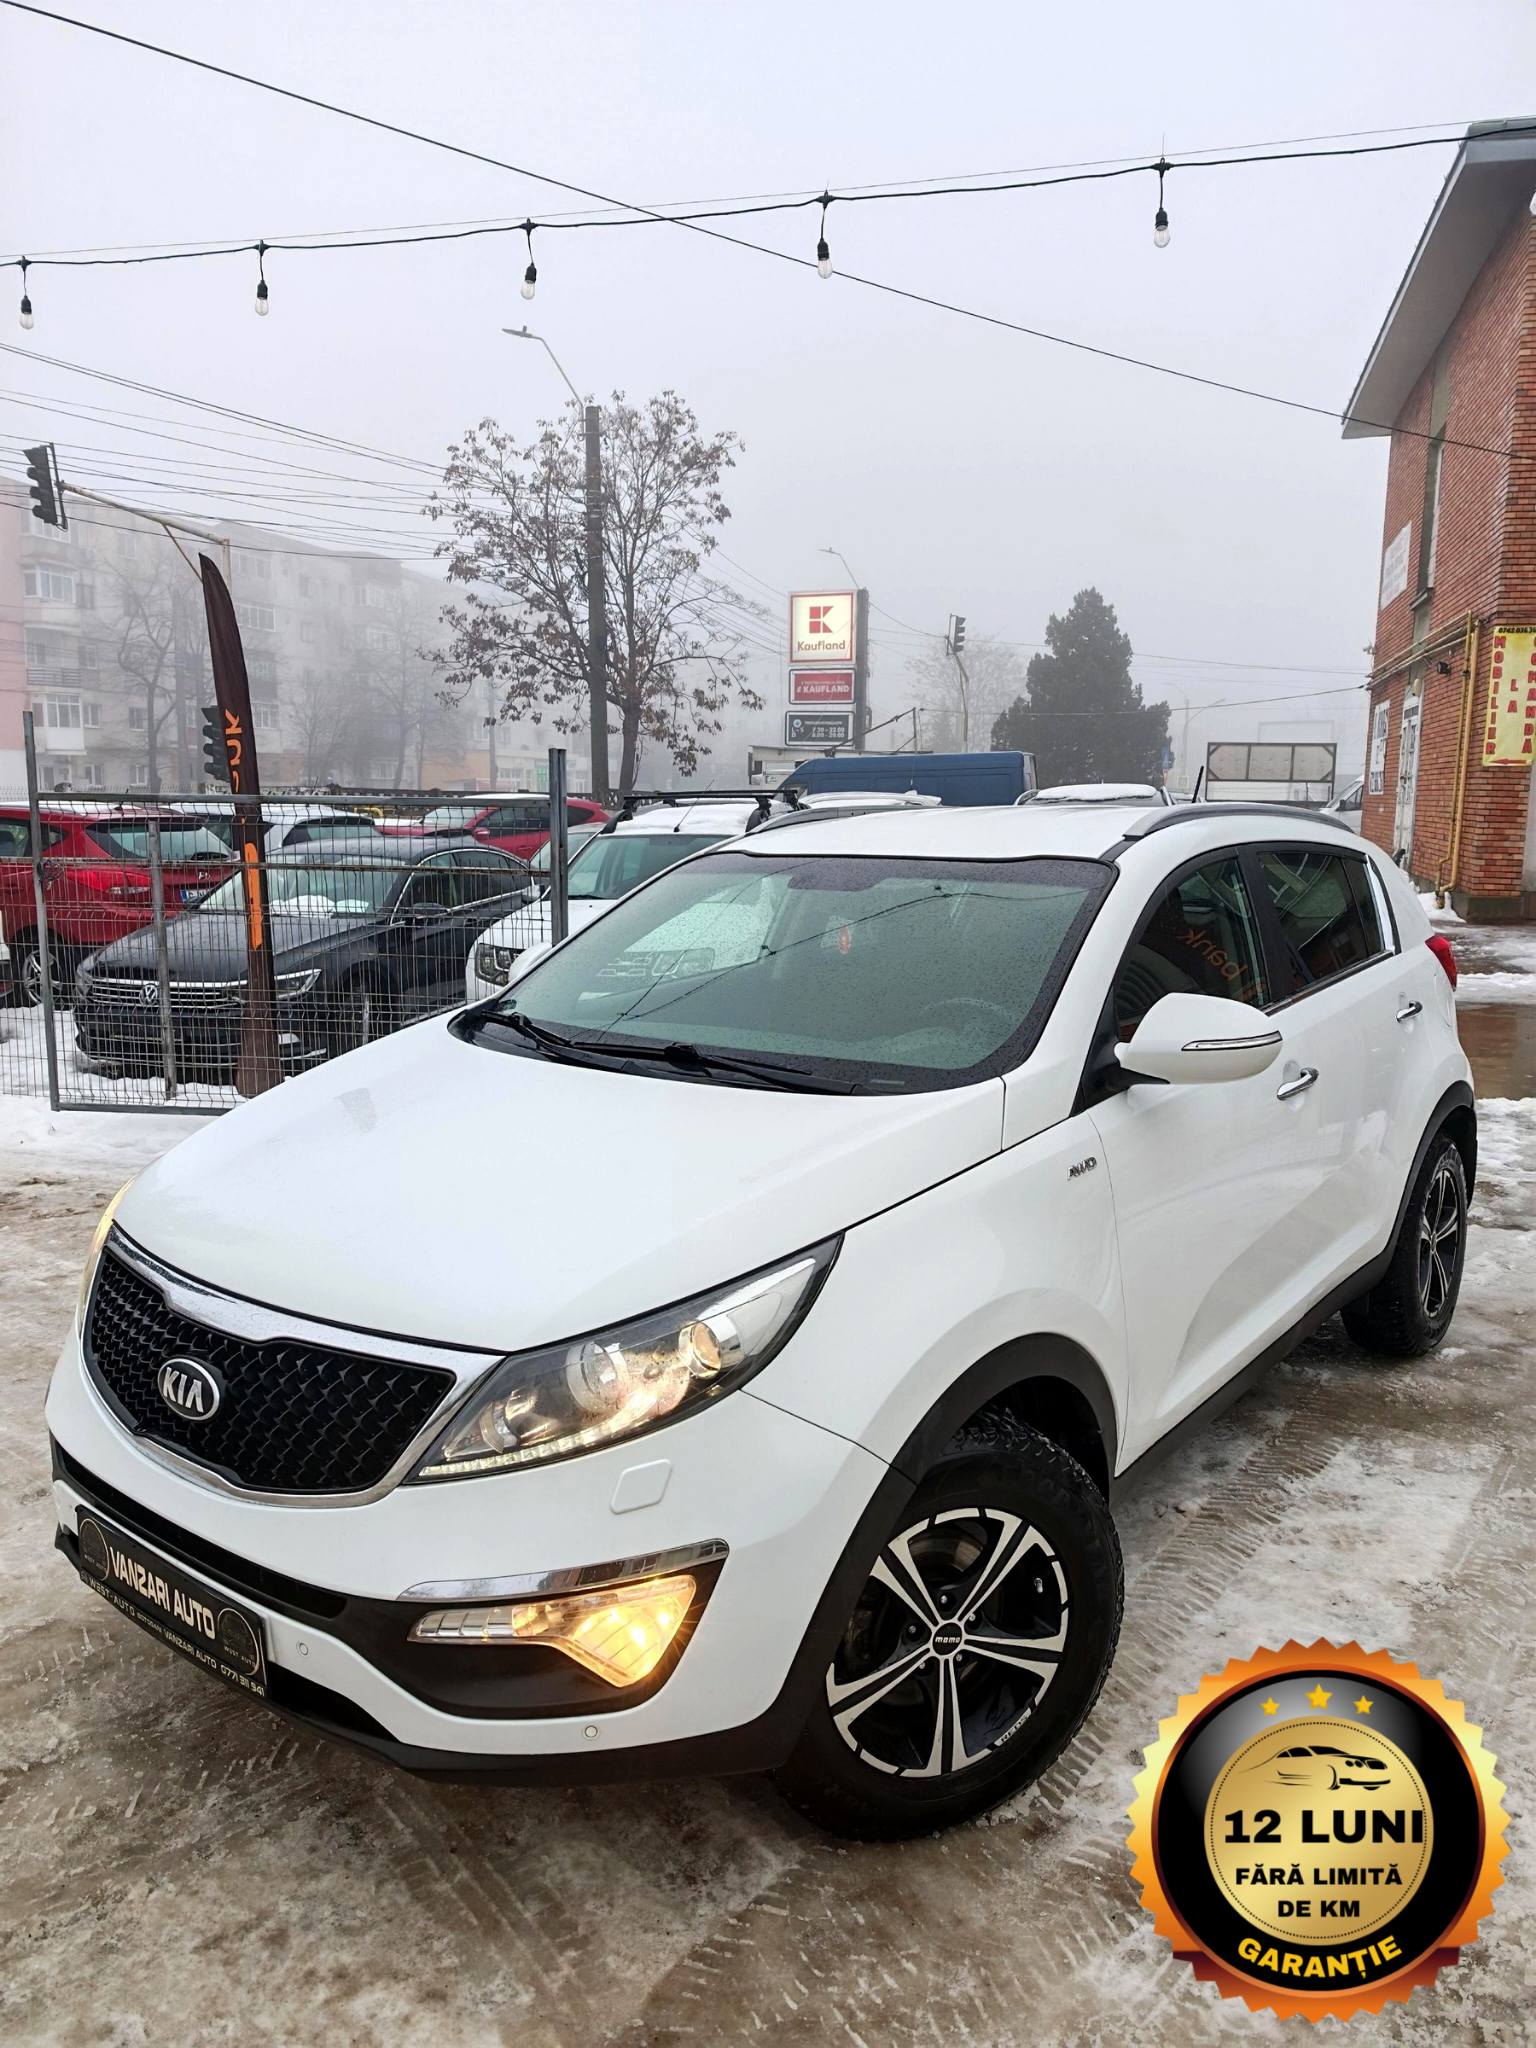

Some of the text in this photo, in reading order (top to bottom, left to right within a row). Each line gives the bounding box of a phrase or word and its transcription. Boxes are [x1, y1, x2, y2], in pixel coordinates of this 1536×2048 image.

[797, 640, 846, 651] Kaufland
[803, 685, 850, 694] KAUFLAND
[1485, 635, 1507, 755] MOBILIER
[1522, 636, 1536, 753] OMANDA
[163, 1366, 204, 1413] KIA
[110, 1546, 215, 1640] VANZARI AUTO
[163, 1628, 195, 1655] VANZARI
[195, 1650, 217, 1669] AUTO
